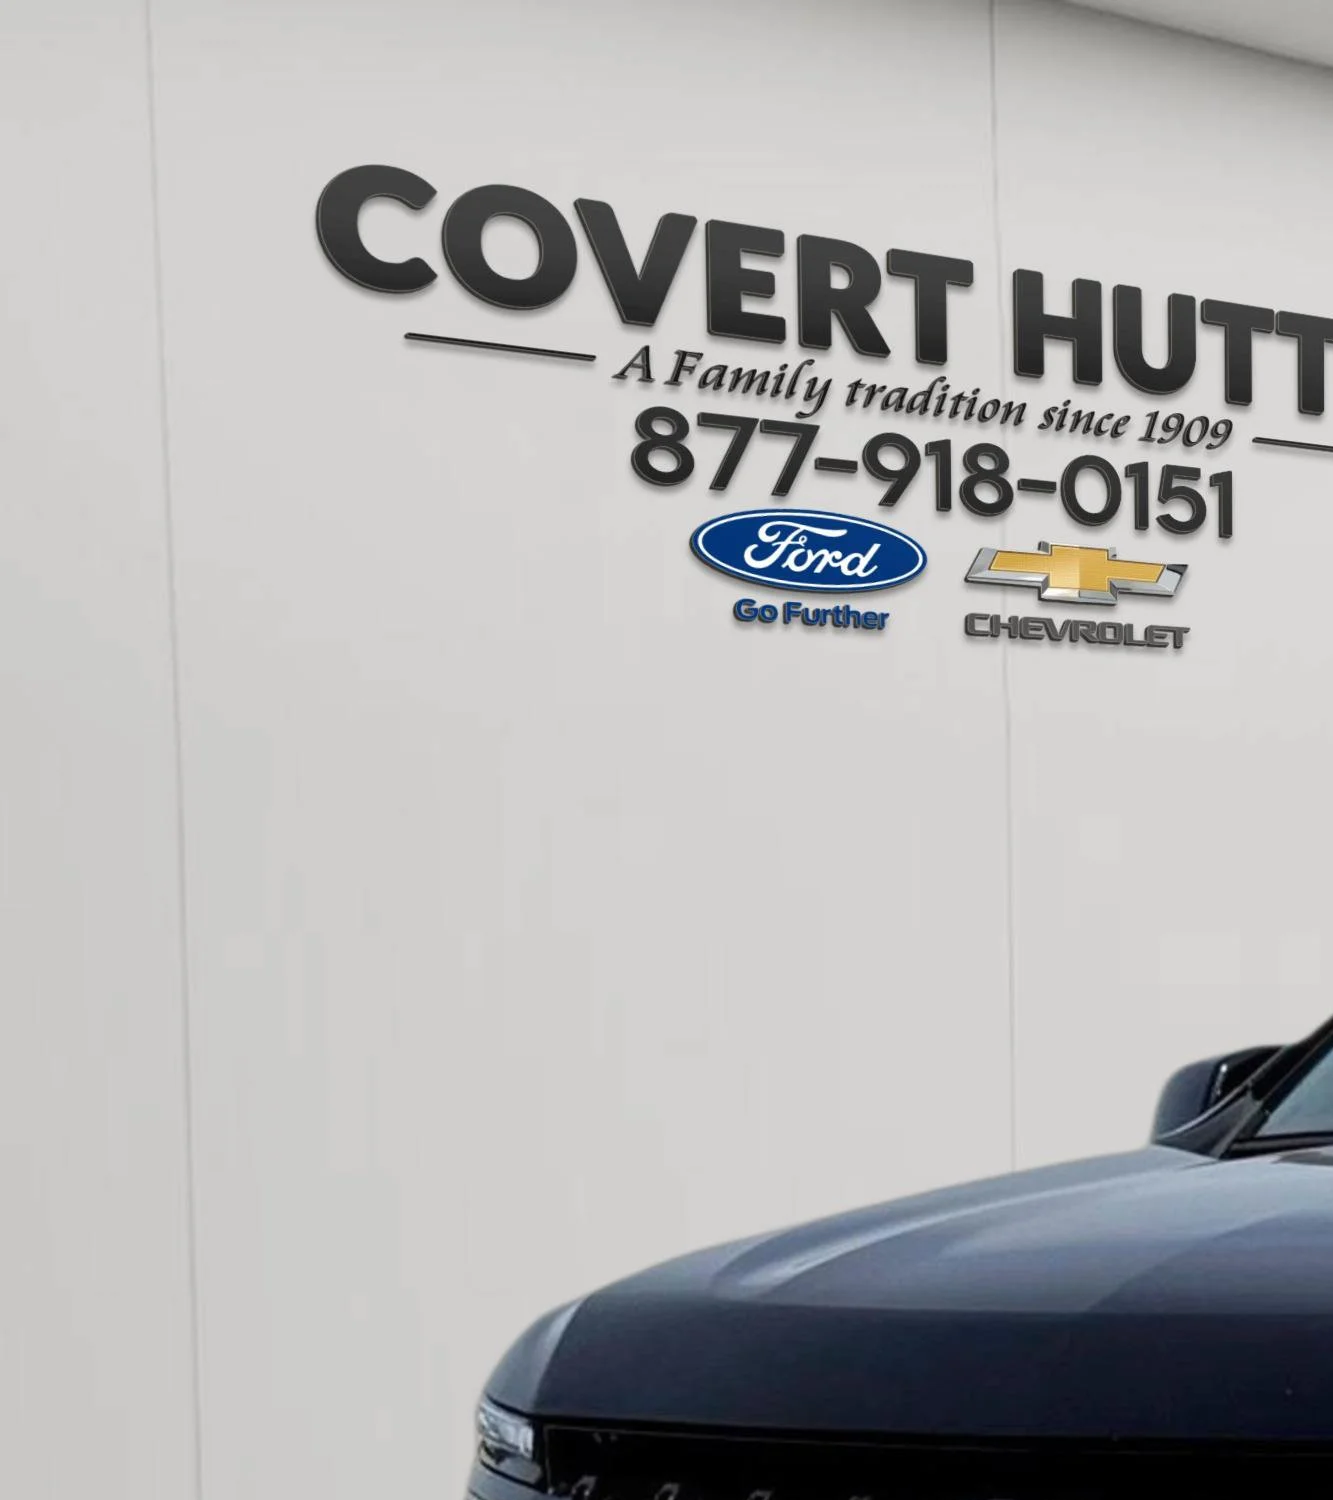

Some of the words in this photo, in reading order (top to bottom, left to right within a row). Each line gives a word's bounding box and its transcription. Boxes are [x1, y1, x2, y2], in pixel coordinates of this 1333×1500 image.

[314, 163, 975, 369] COVERT
[611, 343, 656, 385] A
[663, 348, 833, 420] Family
[845, 374, 1028, 428] tradition
[1037, 396, 1132, 441] since
[1137, 409, 1235, 452] 1909
[629, 405, 1234, 541] 877-918-0151
[743, 517, 880, 582] Ford
[732, 598, 779, 627] Go
[783, 600, 891, 633] Further
[963, 611, 1192, 651] CHEVROLET
